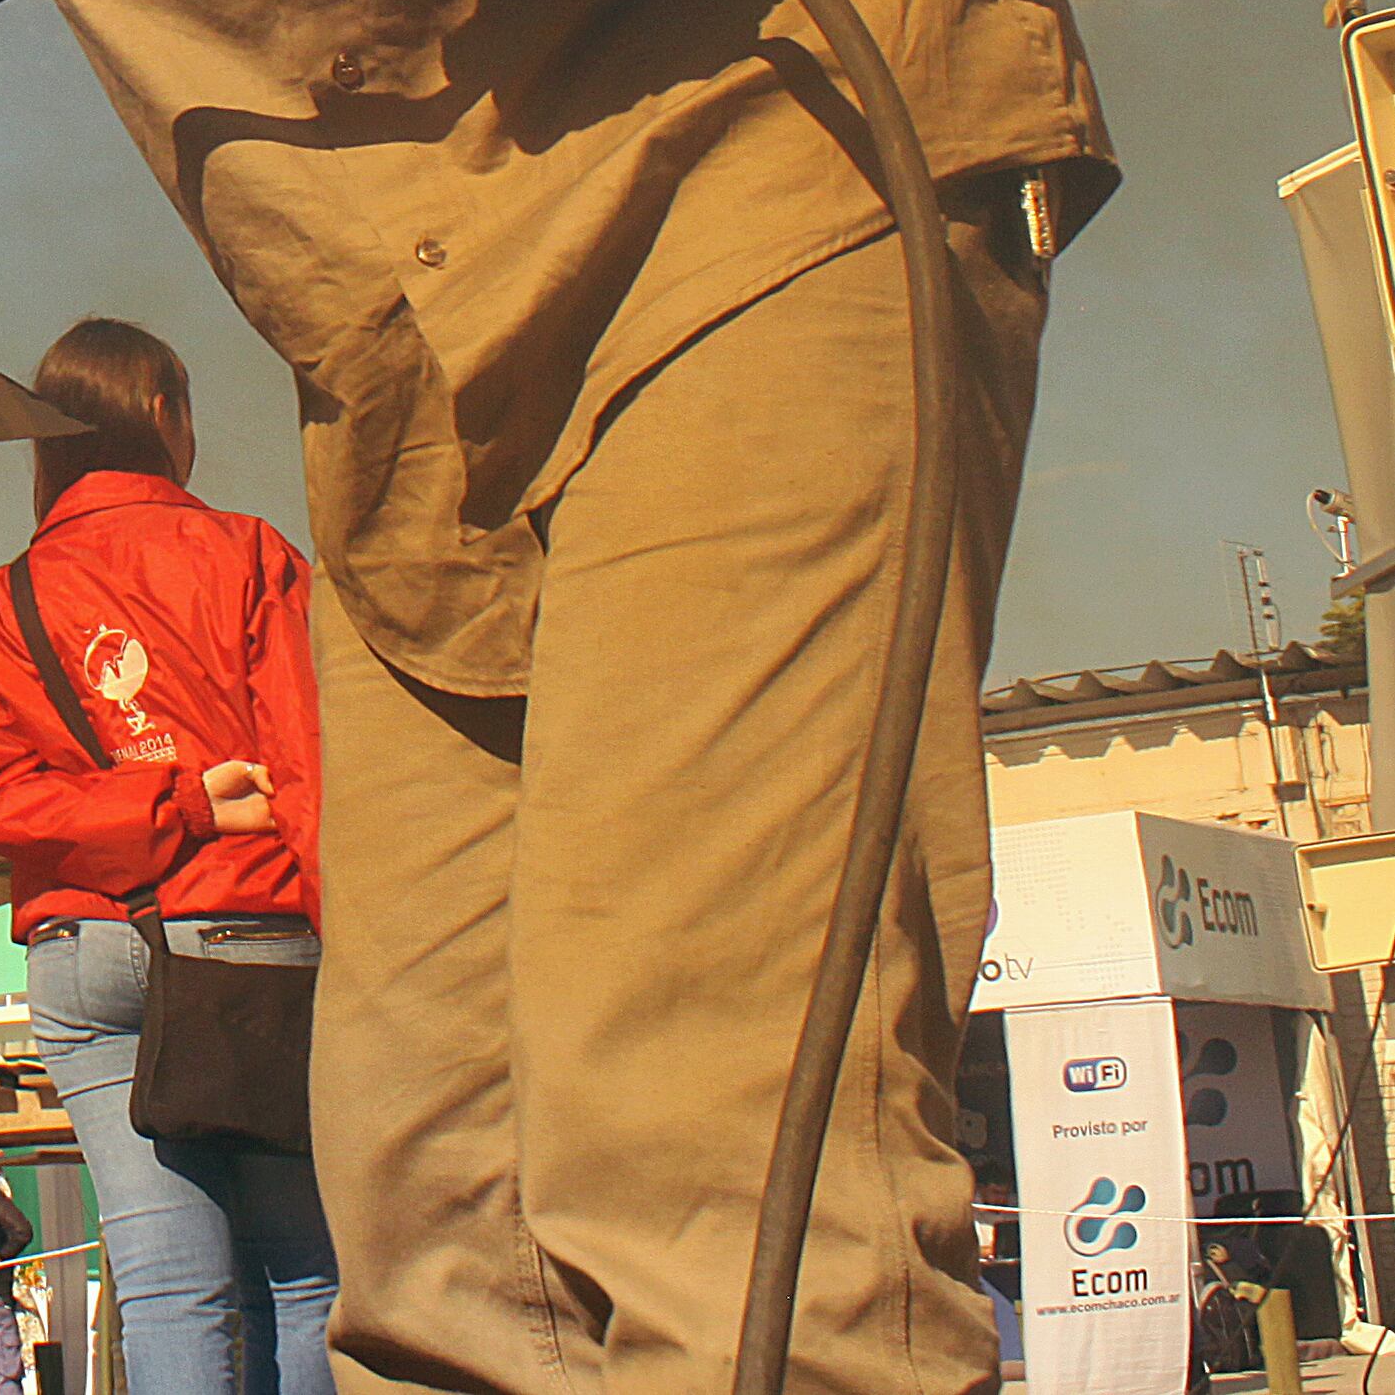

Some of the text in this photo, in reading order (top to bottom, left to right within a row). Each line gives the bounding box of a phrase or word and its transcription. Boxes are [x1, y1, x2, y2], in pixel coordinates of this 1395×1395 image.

[139, 733, 174, 755] 2014
[1199, 877, 1259, 937] Ecom
[1052, 1119, 1148, 1139] Provisto por
[1188, 1158, 1255, 1197] om
[1071, 1268, 1148, 1297] Ecom
[1036, 1293, 1180, 1315] www.ecomchaco.com.ar
